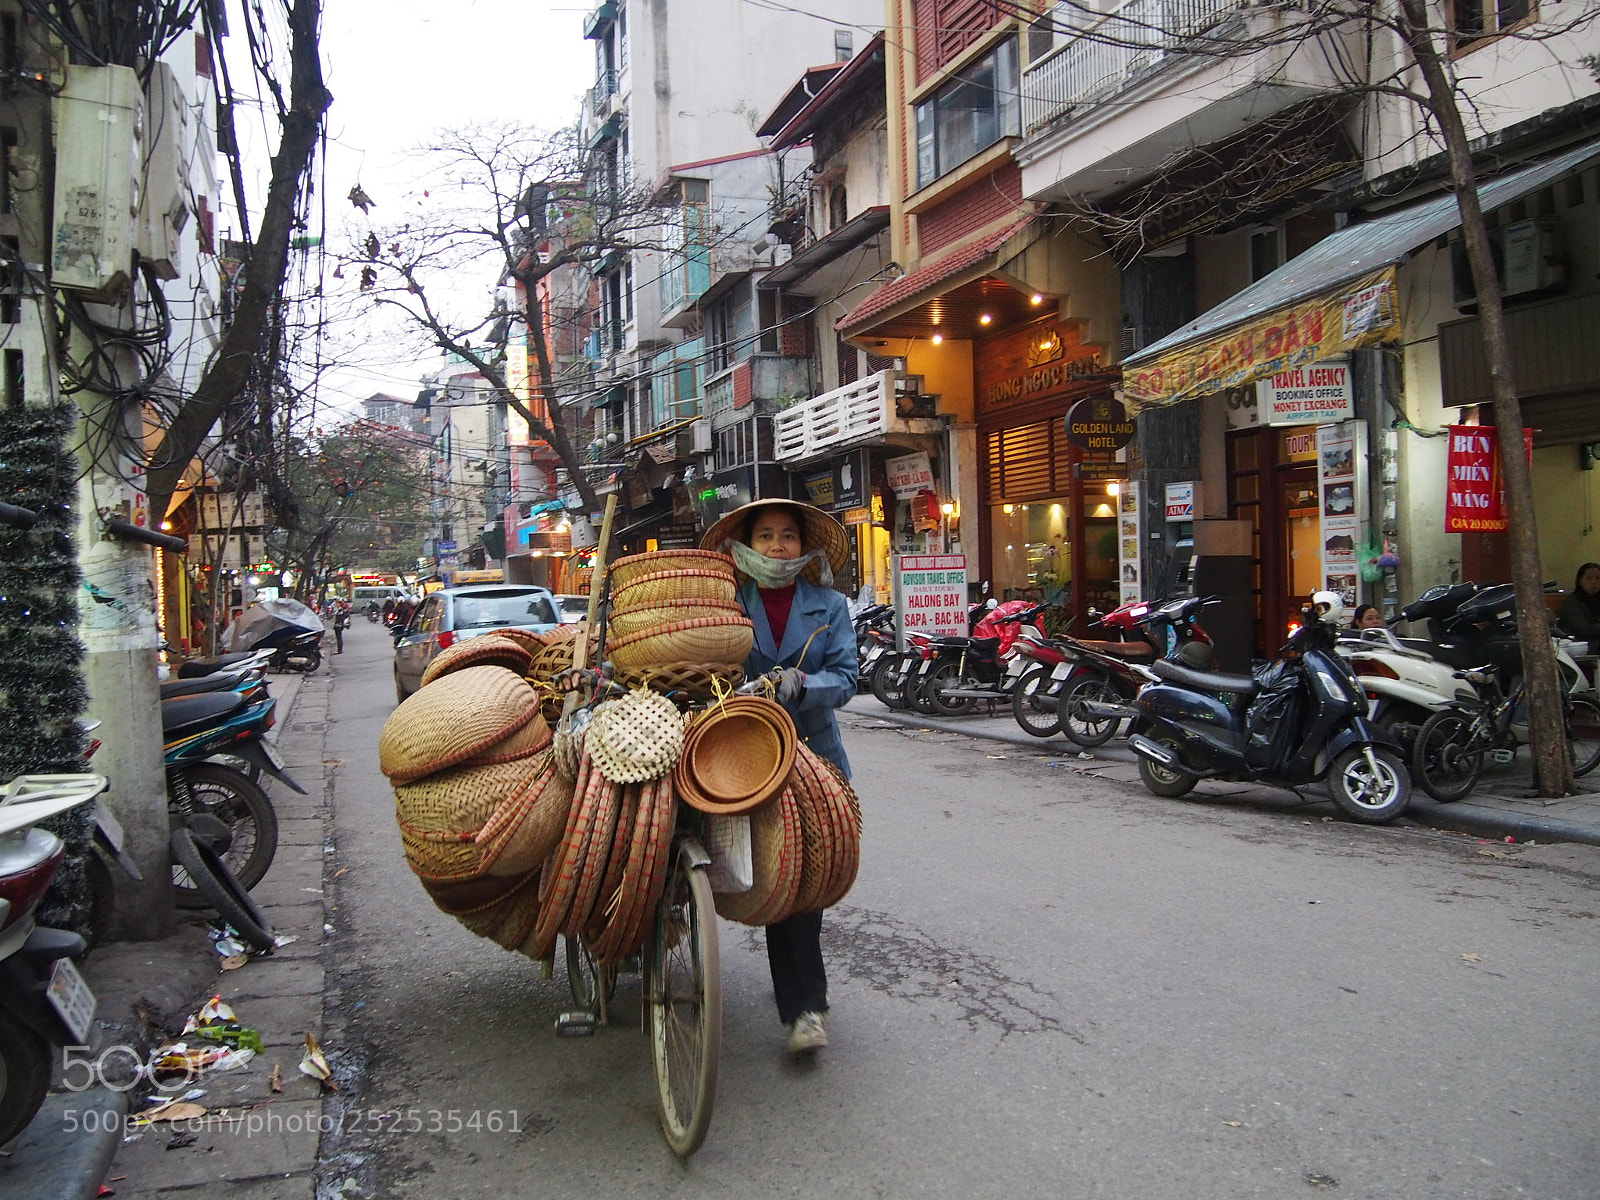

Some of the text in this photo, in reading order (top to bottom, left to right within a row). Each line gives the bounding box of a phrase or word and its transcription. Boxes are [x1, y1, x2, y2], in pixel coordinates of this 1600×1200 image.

[1271, 367, 1346, 389] TRAVEL AGENCY
[1276, 388, 1344, 400] BOOKING OFFICE
[1273, 399, 1348, 413] MONEY EXCHANGE
[1286, 410, 1338, 420] AIRPORT TAXI
[1088, 437, 1118, 448] HOTEL
[1453, 430, 1490, 453] BÚN
[1452, 458, 1490, 481] MIẾN
[1450, 489, 1490, 509] MĂNG
[1168, 506, 1185, 516] ATM
[903, 571, 964, 586] ADVISOR TRAVEL OFFICE
[908, 593, 960, 608] HALONG BAY
[904, 613, 927, 627] SAPA
[935, 611, 952, 625] BAC
[953, 611, 965, 624] HA
